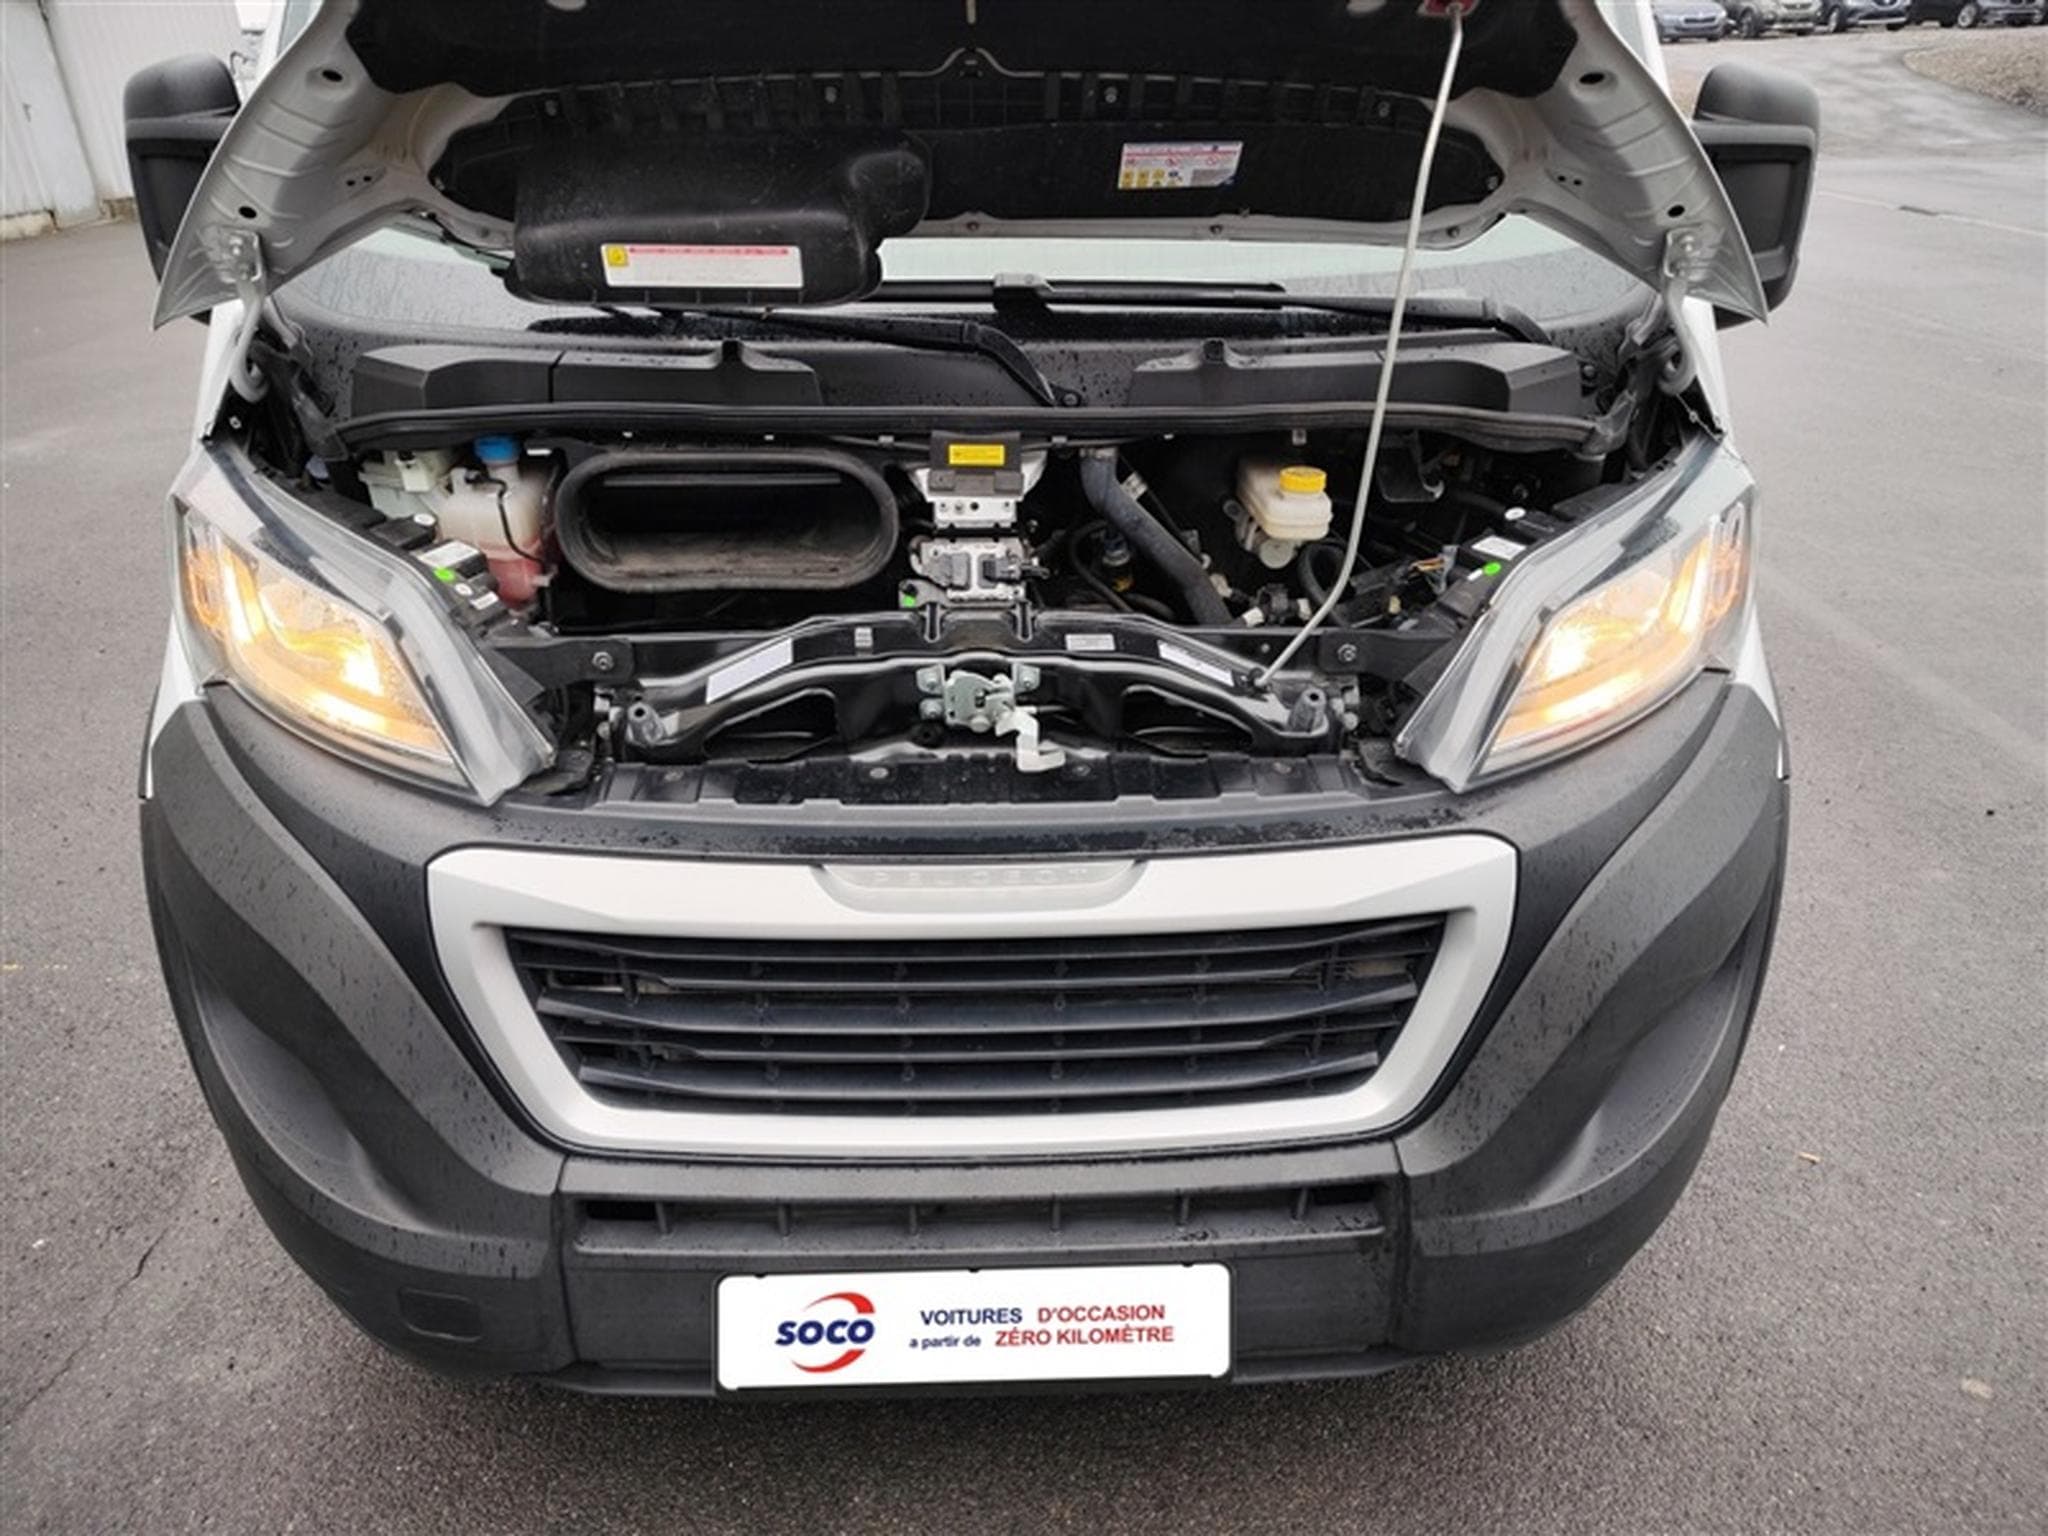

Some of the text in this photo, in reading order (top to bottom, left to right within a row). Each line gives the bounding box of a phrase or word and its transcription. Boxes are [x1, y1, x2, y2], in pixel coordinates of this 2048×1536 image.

[920, 1305, 1165, 1326] VOITURES D'OCCASION
[775, 1319, 875, 1346] SOCO
[921, 1336, 959, 1350] partir
[964, 1334, 981, 1347] de
[995, 1328, 1052, 1347] ZÉRO
[1058, 1325, 1175, 1344] KILOMÈTRE
